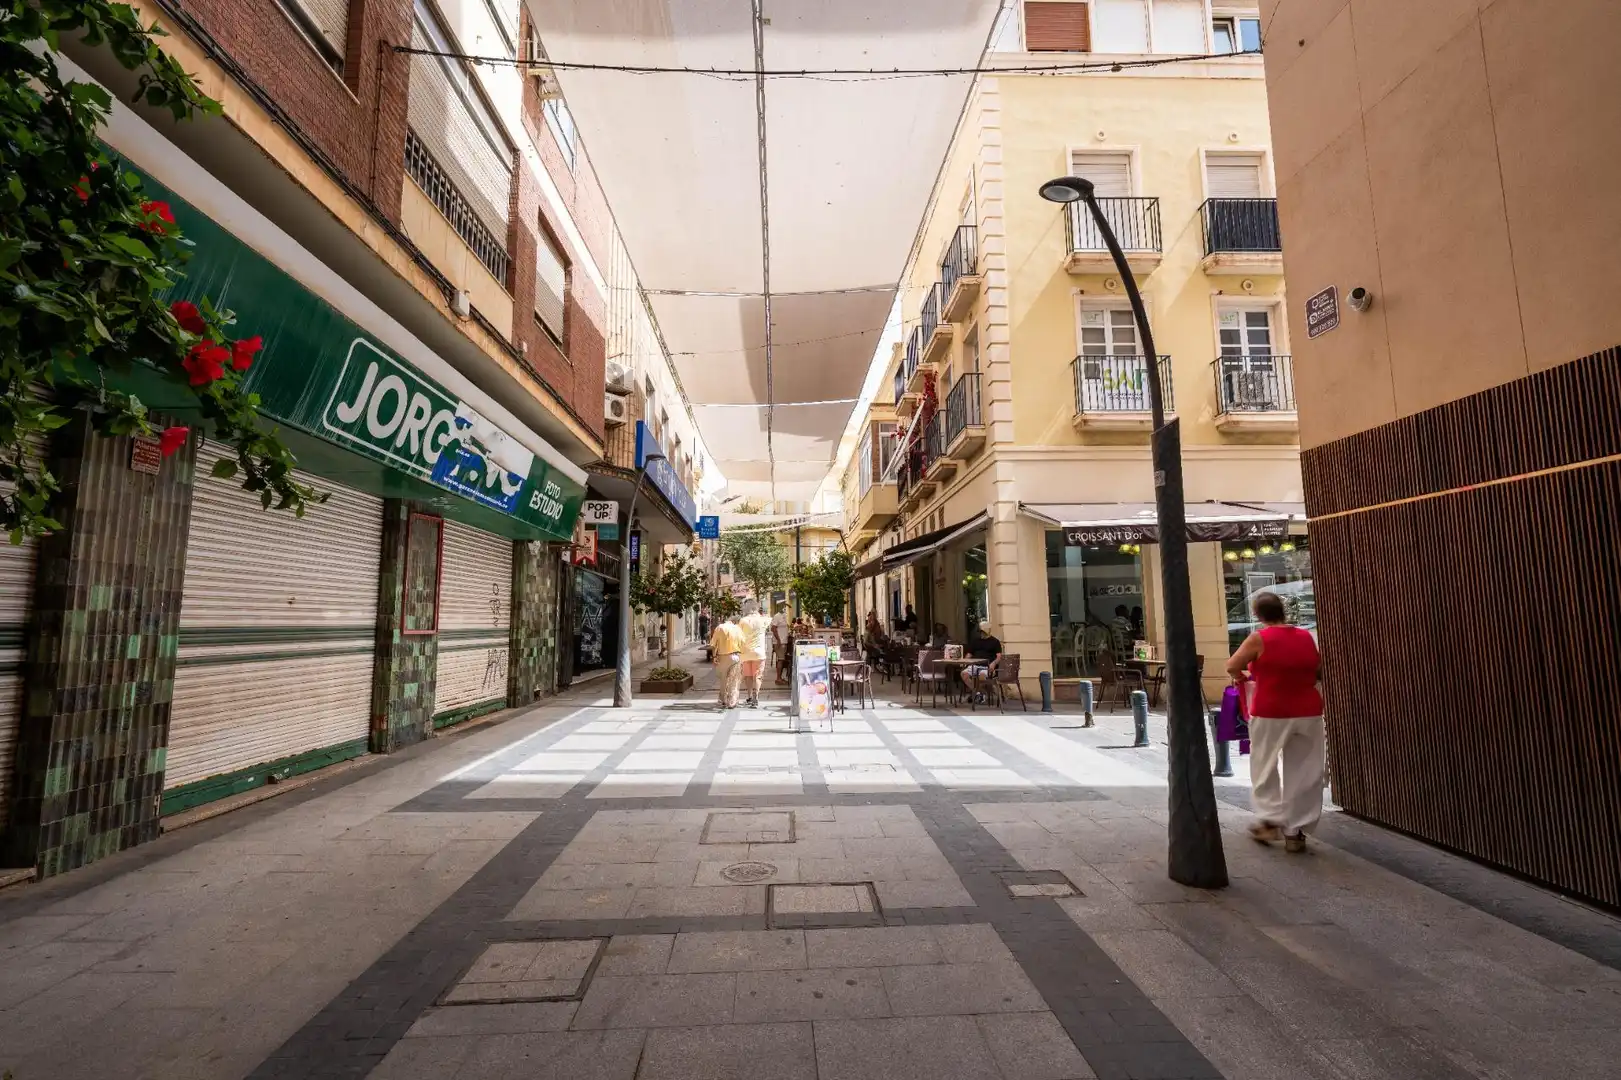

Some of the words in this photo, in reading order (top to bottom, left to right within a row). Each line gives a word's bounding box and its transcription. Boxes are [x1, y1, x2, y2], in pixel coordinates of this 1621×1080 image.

[544, 480, 561, 500] FOTO
[529, 489, 564, 520] ESTUDIO
[587, 503, 609, 511] POP
[594, 511, 609, 520] UP
[1068, 531, 1121, 542] CROISSANT
